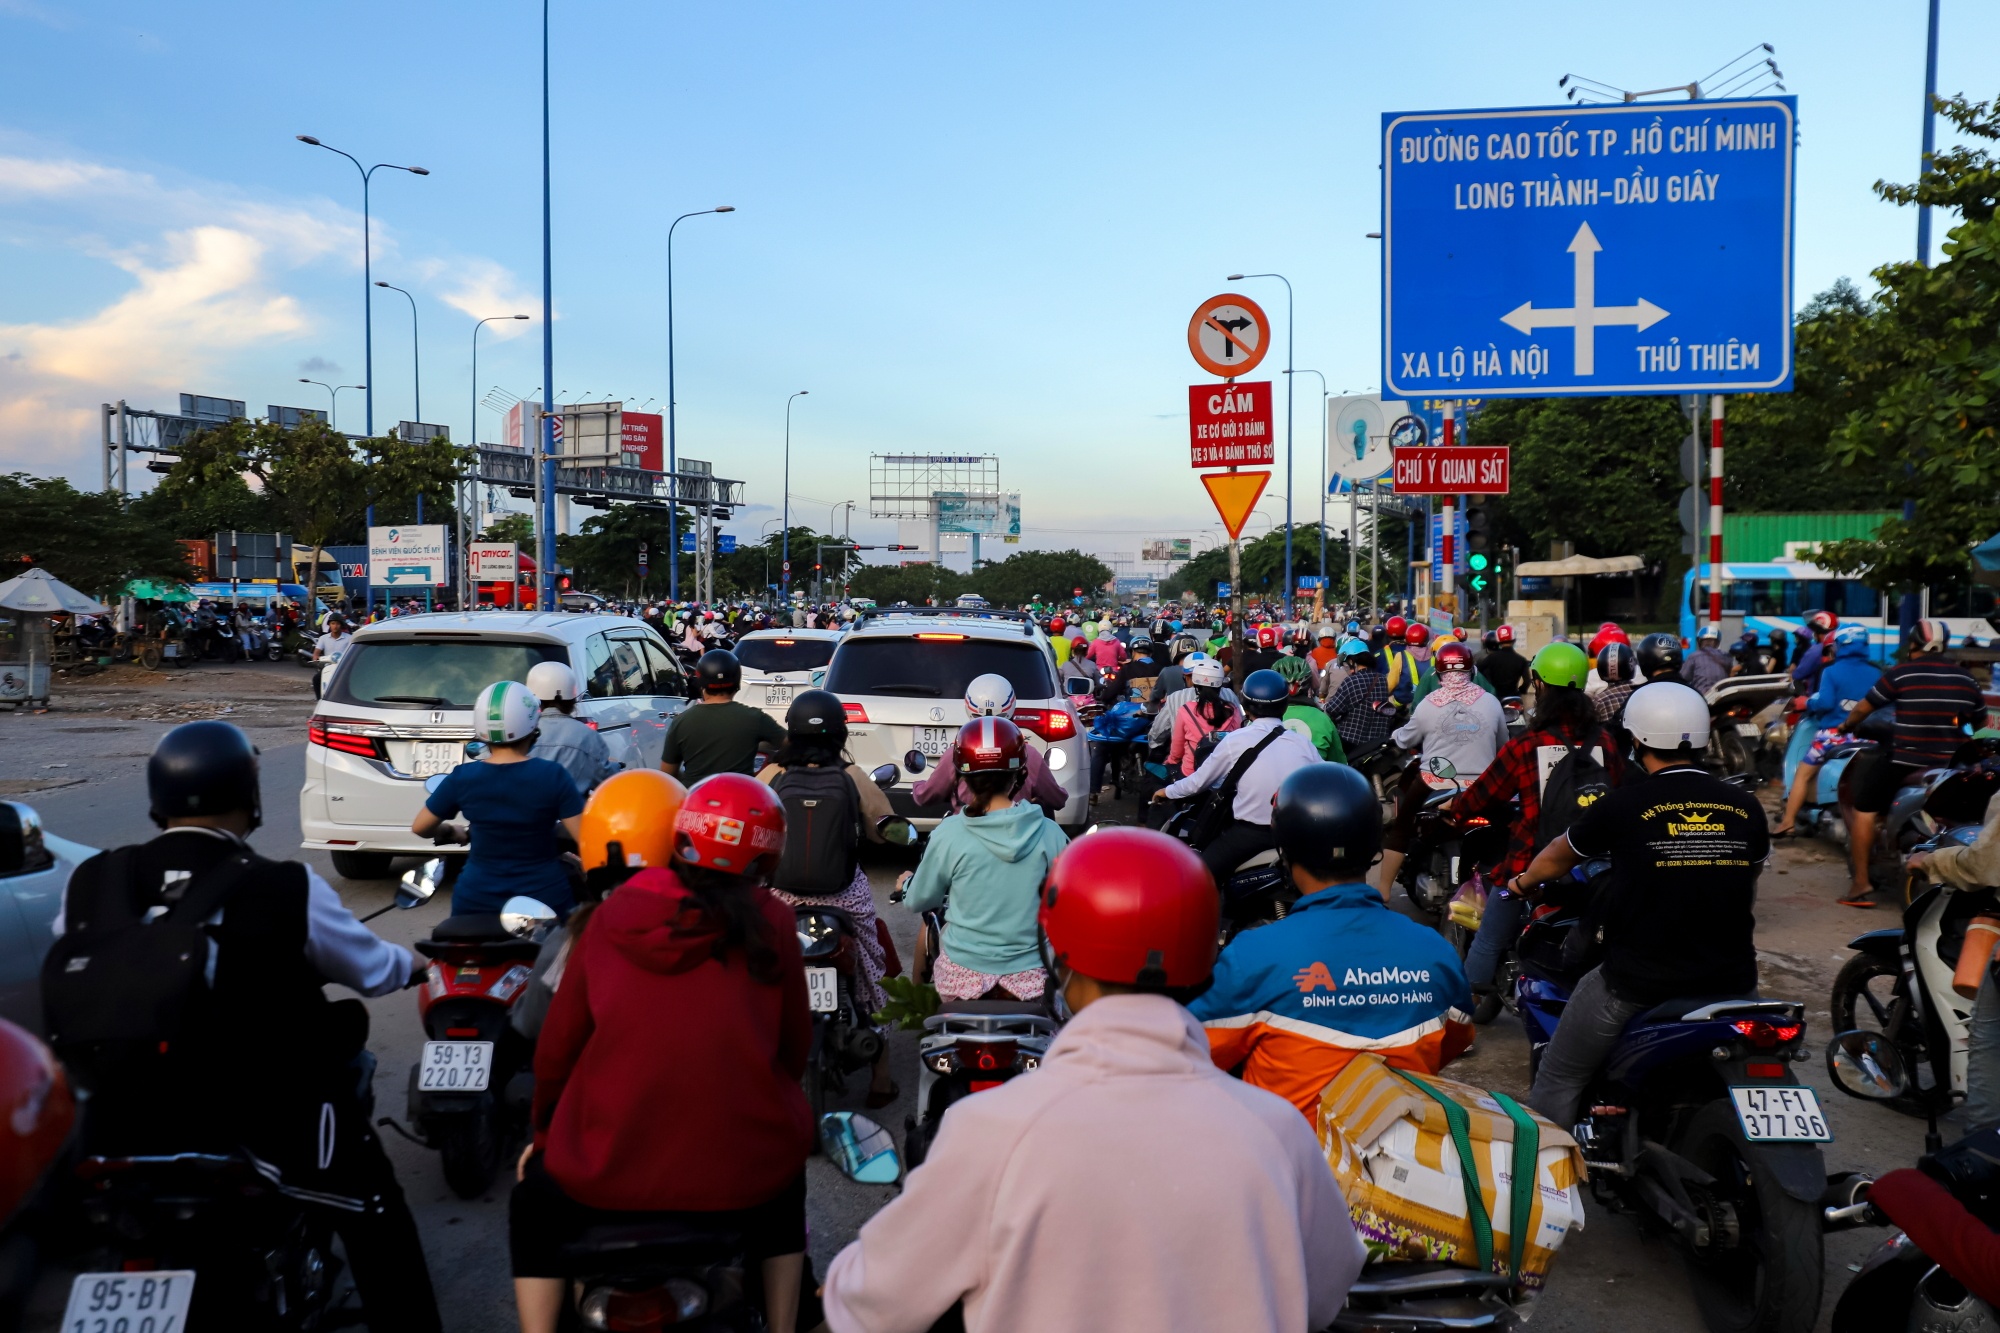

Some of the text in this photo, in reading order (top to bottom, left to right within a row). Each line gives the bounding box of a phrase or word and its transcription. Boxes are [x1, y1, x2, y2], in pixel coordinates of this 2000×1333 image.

[1400, 128, 1479, 163] ĐƯỜNG
[1486, 132, 1530, 160] CAO
[1535, 120, 1579, 158] TỐC
[1670, 118, 1711, 154] CHÍ
[1716, 122, 1776, 151] MINH
[1455, 183, 1515, 210] LONG
[1667, 169, 1720, 203] GIÂY
[1401, 342, 1549, 382] XA LỘ HÀ NỘI
[1636, 337, 1760, 373] THỦ THIÊM
[1208, 386, 1254, 415] CẤM
[1197, 418, 1265, 439] XE CƠ GIỚI 3 BÁNH
[1203, 447, 1208, 461] 3
[1209, 443, 1218, 461] VÀ
[1218, 446, 1223, 460] 4
[1225, 441, 1245, 460] BÁNH
[1247, 442, 1261, 459] THÔ
[1263, 441, 1274, 459] SƠ
[1397, 452, 1504, 484] CHÚ Ý QUAN SÁT
[372, 546, 388, 556] BỆNH
[388, 546, 402, 556] VIỆN
[402, 544, 422, 554] QUỐC
[772, 688, 786, 696] 51G
[924, 728, 948, 742] 51A
[425, 744, 451, 760] 51H
[1654, 802, 1684, 813] Thống
[1686, 801, 1734, 812] showroom
[1343, 966, 1430, 986] AhaMove
[1338, 994, 1366, 1006] CAO
[1368, 993, 1399, 1005] GIAO
[1402, 990, 1433, 1004] HÀNG
[434, 1045, 482, 1065] 59-Y3
[424, 1067, 486, 1088] 220.72
[1747, 1090, 1807, 1112] 47-F1
[1746, 1114, 1825, 1137] 377.96
[88, 1278, 172, 1312] 95-B1
